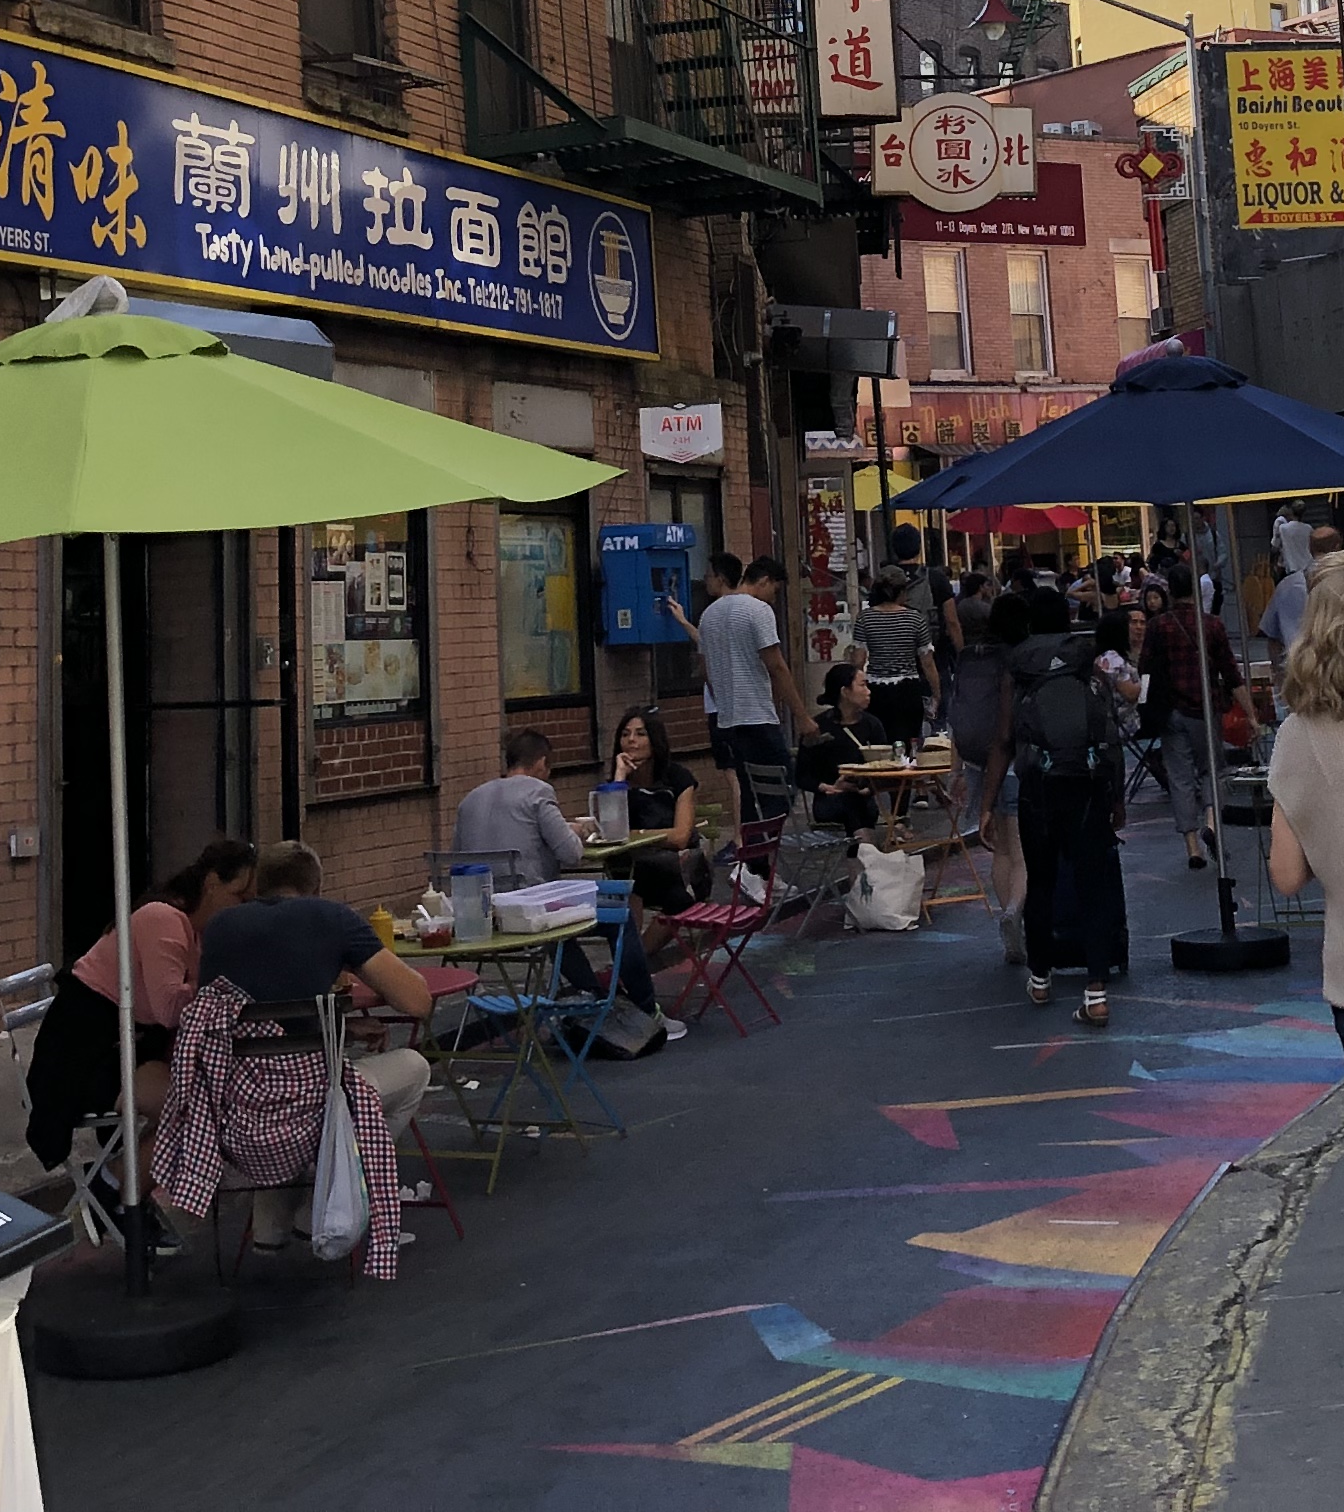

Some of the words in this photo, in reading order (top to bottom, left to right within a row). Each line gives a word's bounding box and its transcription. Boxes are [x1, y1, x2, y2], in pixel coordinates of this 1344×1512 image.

[1236, 94, 1289, 114] Baishi
[1241, 181, 1324, 210] LIQUOR
[936, 221, 955, 232] 11-13
[1272, 213, 1316, 223] DOYERS
[33, 232, 53, 253] ST.
[195, 223, 253, 278] Tasty
[258, 235, 365, 290] hand-pulled
[367, 262, 433, 299] noodles
[435, 268, 467, 304] Inc.
[661, 415, 702, 432] ATM
[666, 525, 685, 543] ATM
[602, 536, 638, 551] ATM
